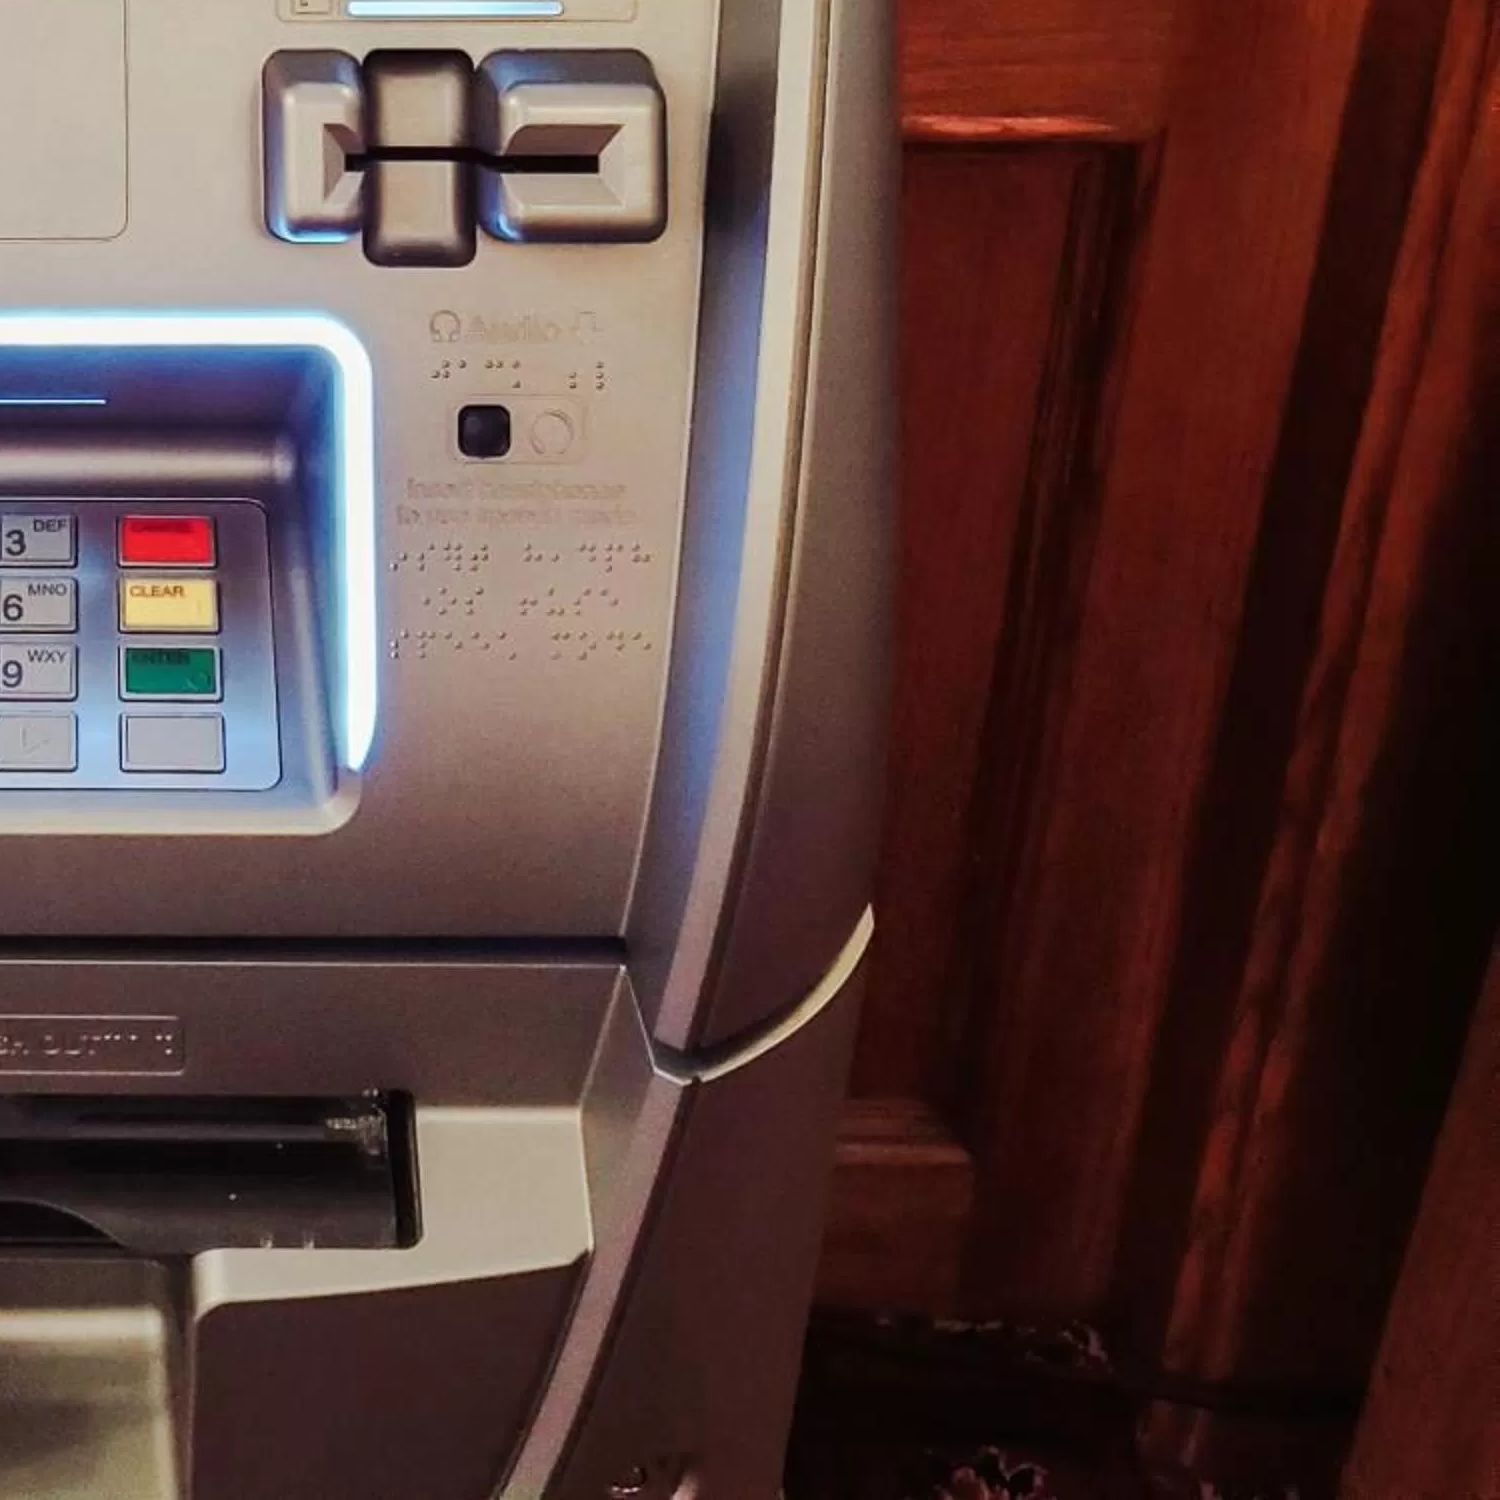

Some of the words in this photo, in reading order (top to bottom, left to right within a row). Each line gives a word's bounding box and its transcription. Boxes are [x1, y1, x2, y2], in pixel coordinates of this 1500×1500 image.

[5, 530, 26, 556] 3
[33, 519, 67, 532] DEF
[3, 595, 24, 621] 6
[27, 583, 67, 596] MNO
[130, 585, 185, 599] CLEAR
[2, 660, 23, 688] 9
[27, 650, 67, 663] WXY
